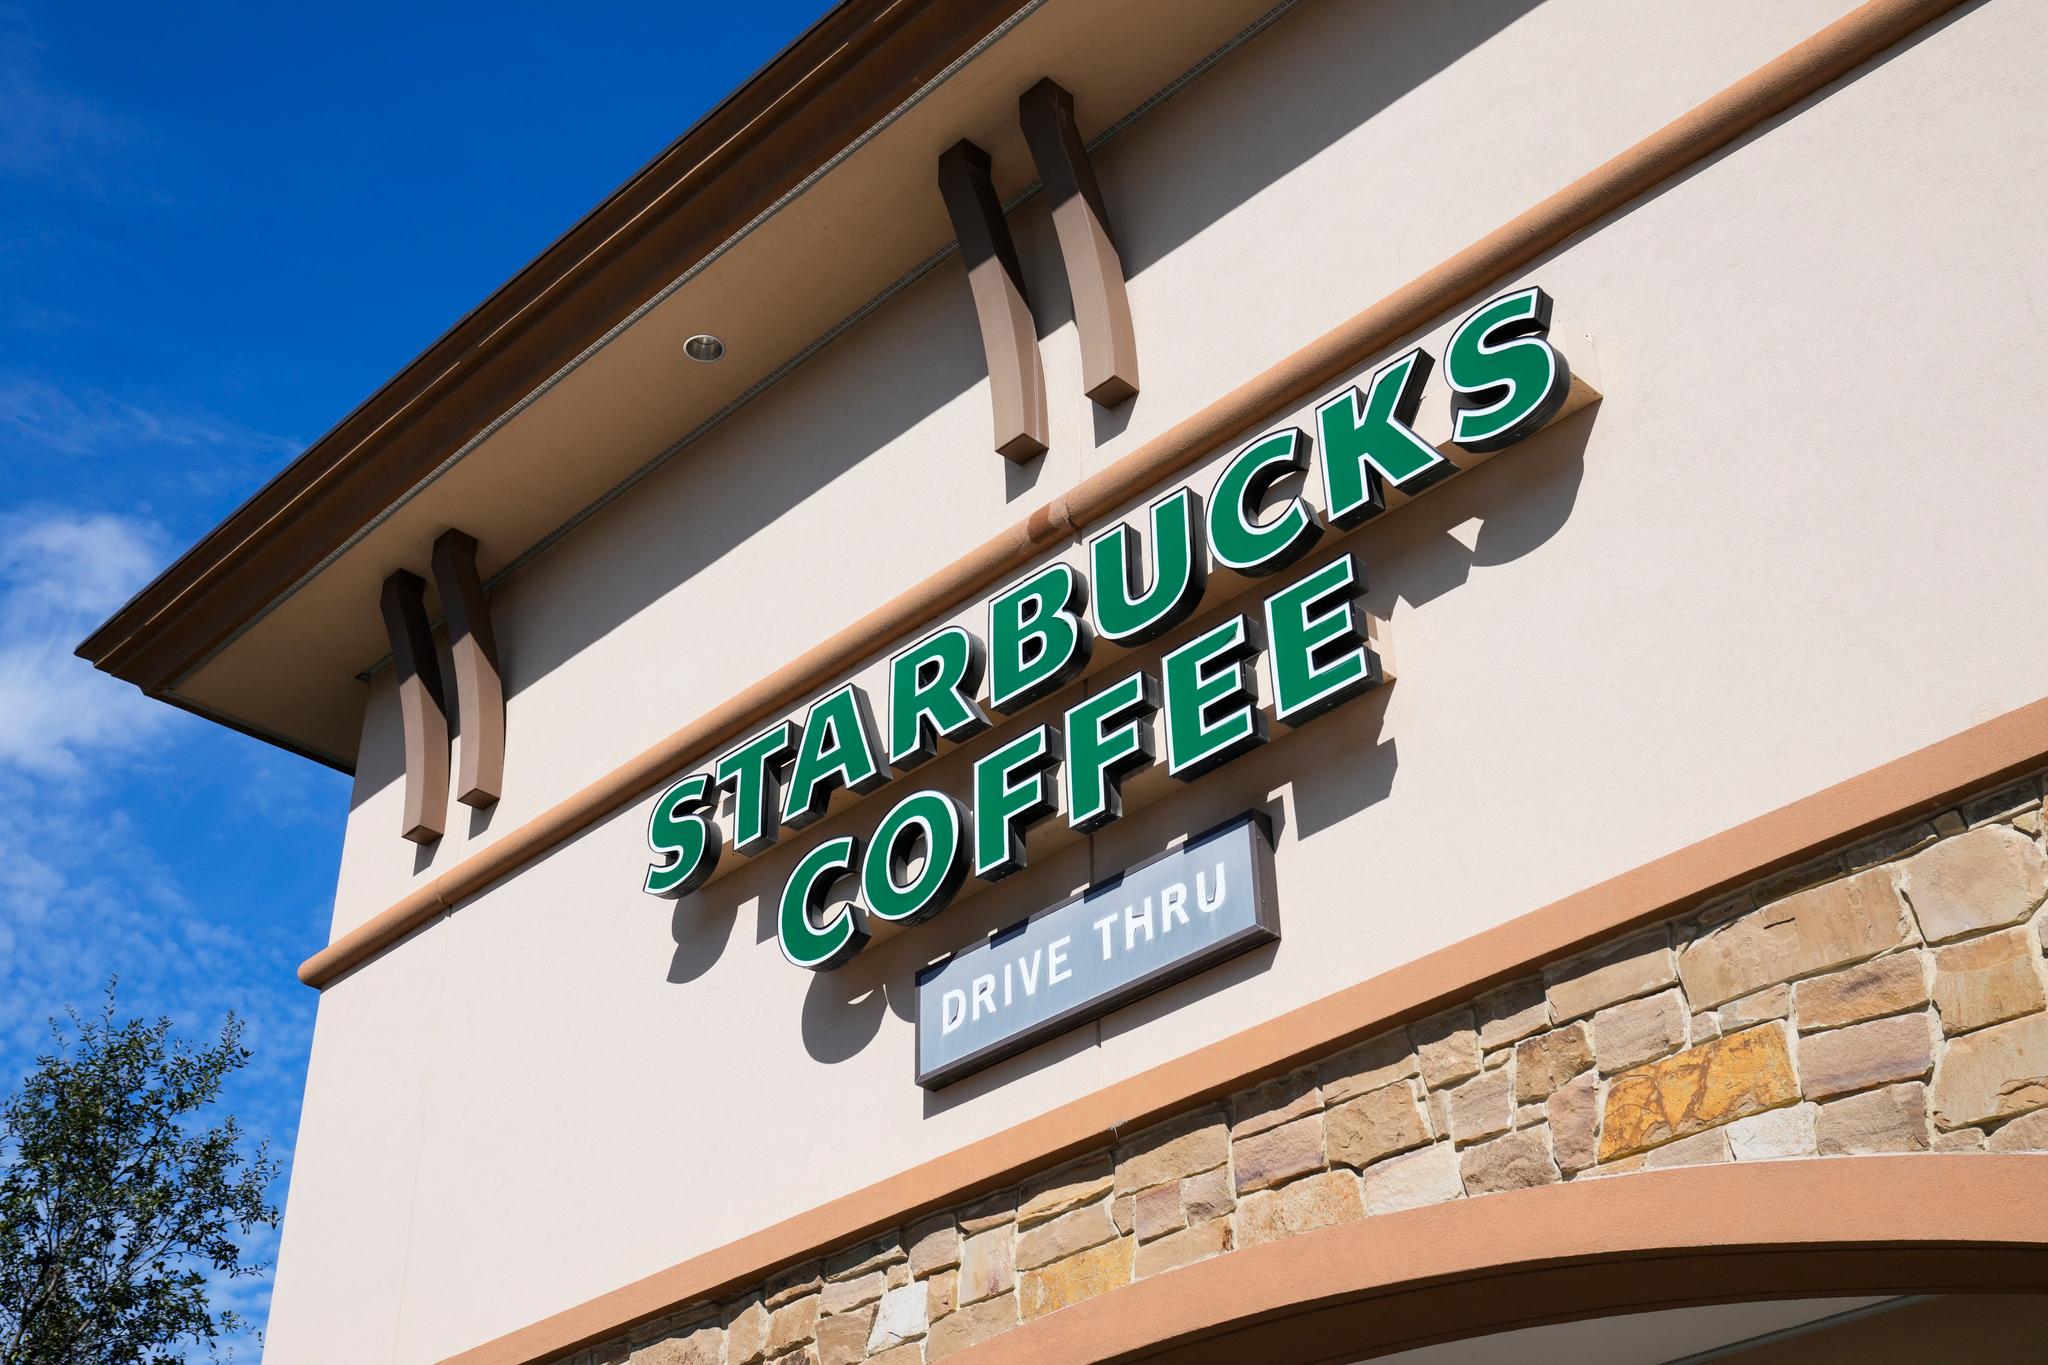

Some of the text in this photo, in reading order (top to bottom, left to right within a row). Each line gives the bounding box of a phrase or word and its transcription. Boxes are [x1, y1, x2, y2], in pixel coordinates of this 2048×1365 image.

[643, 285, 1562, 895] STARBUCKS
[777, 552, 1374, 968] COFFEE
[941, 861, 1227, 1036] DRIVE THRU
